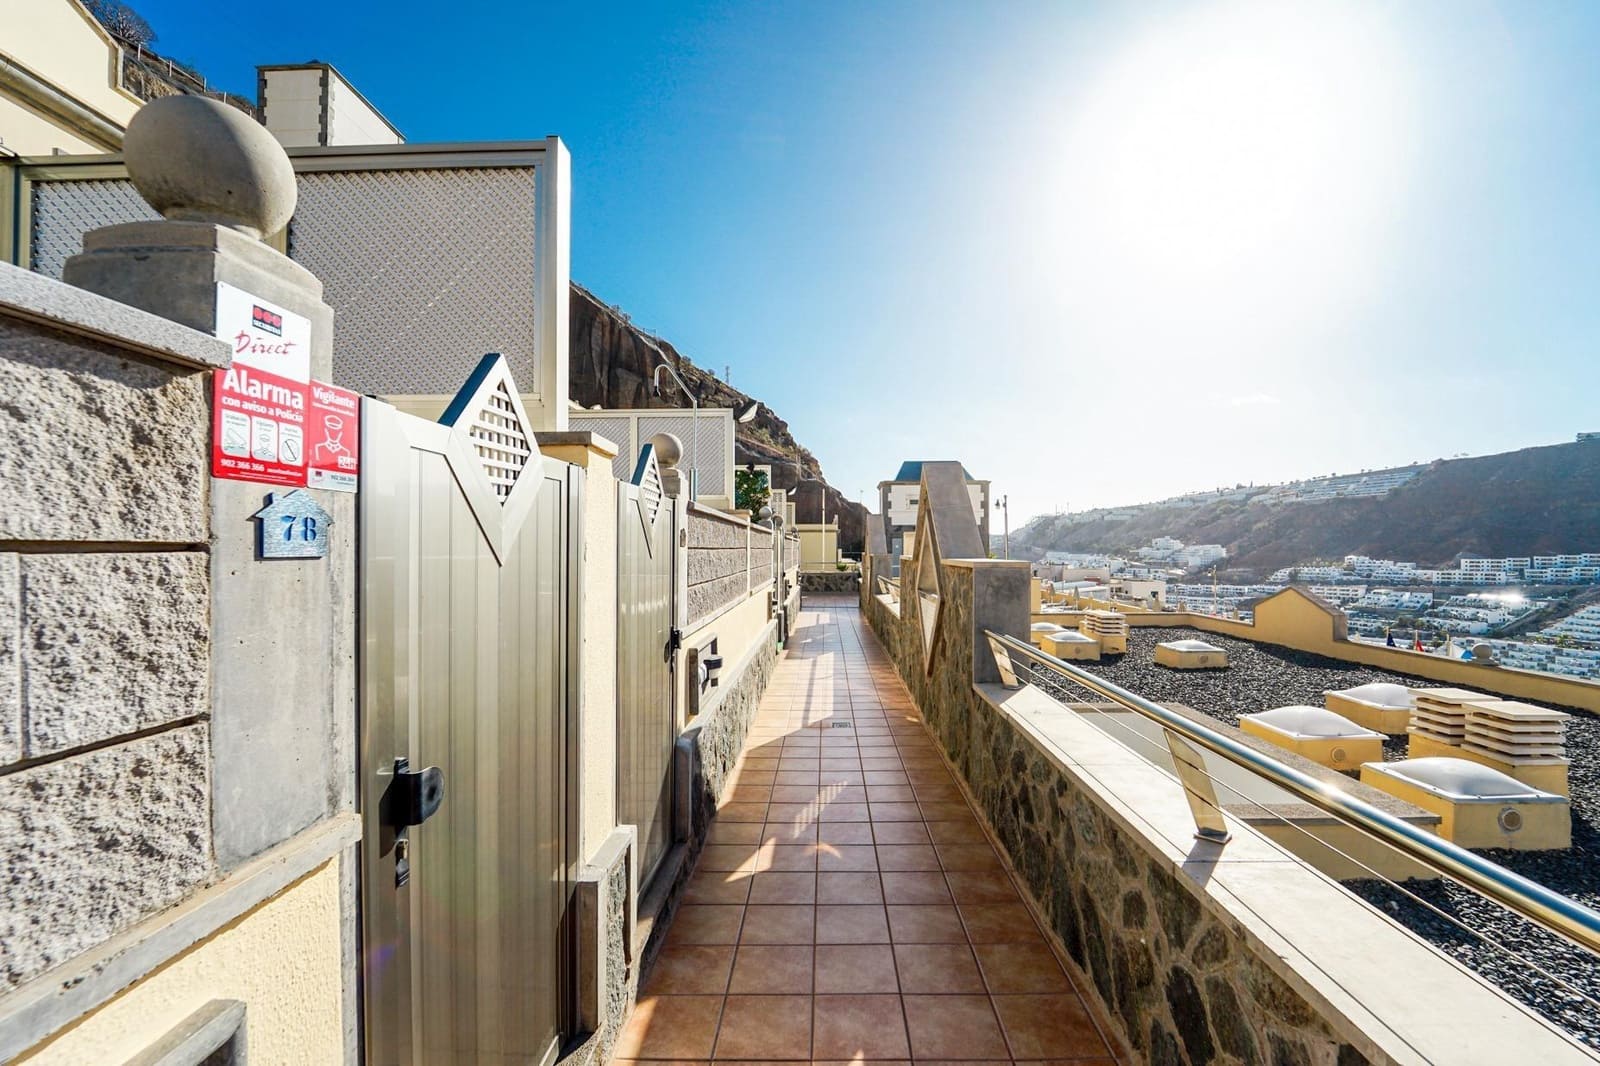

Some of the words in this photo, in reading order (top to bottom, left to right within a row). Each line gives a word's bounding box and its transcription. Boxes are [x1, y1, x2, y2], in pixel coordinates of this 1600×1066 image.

[235, 330, 296, 354] Direct
[222, 367, 304, 409] Alarma
[312, 387, 355, 408] Vigilante
[222, 396, 240, 407] con
[241, 400, 267, 413] aviso
[281, 515, 316, 541] 78
